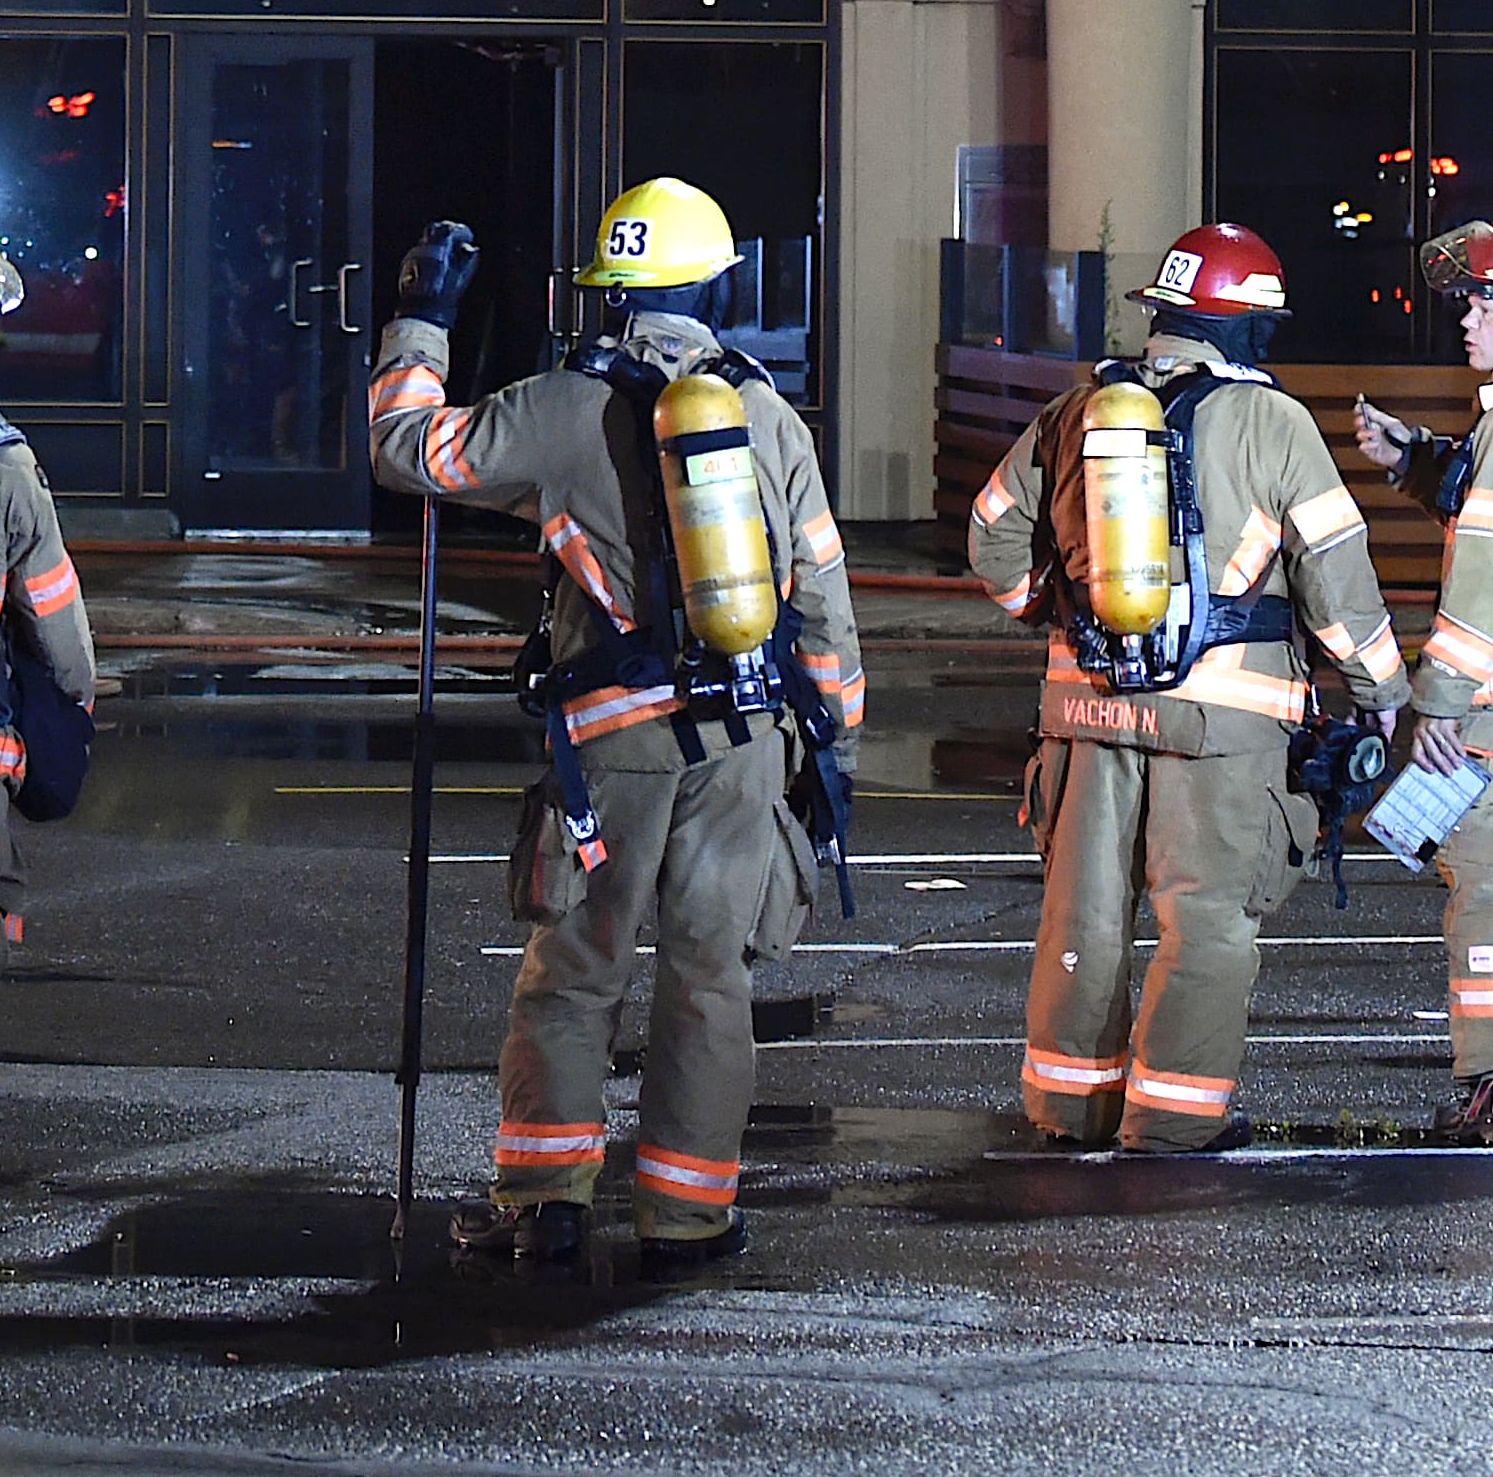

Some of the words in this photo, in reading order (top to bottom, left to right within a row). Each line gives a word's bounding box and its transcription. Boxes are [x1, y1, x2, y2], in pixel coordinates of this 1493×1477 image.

[609, 221, 648, 256] 53
[1165, 256, 1190, 286] 62
[1064, 697, 1137, 731] VACHON
